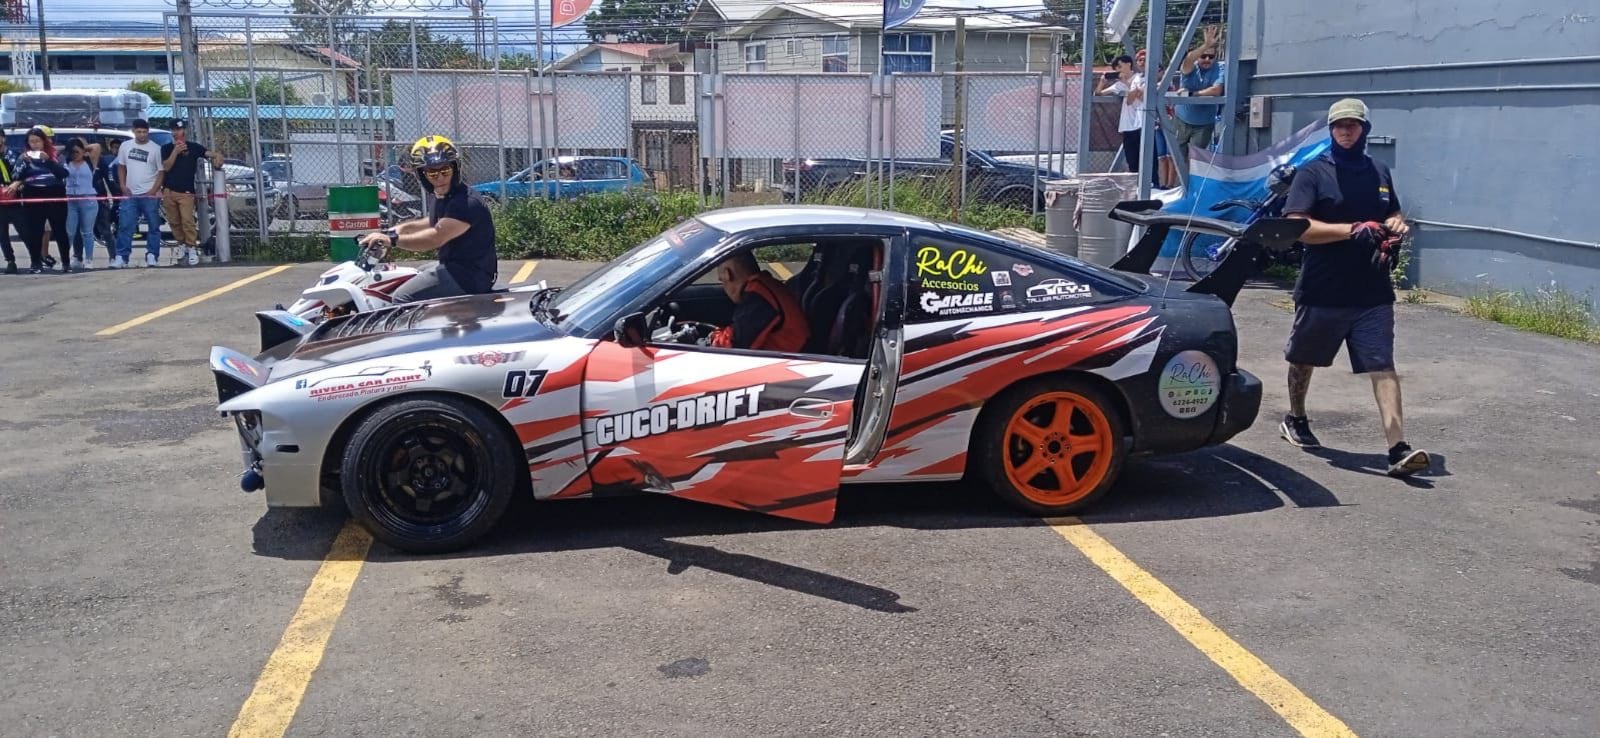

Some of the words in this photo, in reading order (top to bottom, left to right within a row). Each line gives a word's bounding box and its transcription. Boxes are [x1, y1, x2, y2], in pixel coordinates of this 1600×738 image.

[916, 247, 987, 279] RaChi
[921, 278, 980, 292] Accesorios
[920, 291, 994, 314] GARAGE
[939, 304, 994, 316] AUTOMECHANICS
[1026, 295, 1052, 304] TALLER
[310, 383, 354, 395] RIVERA
[358, 379, 383, 388] CAR
[385, 374, 422, 384] PAINT
[502, 369, 549, 399] 07
[1169, 362, 1210, 385] RaChi
[360, 387, 385, 395] Pintura
[596, 383, 767, 446] CUCO-DRIFT
